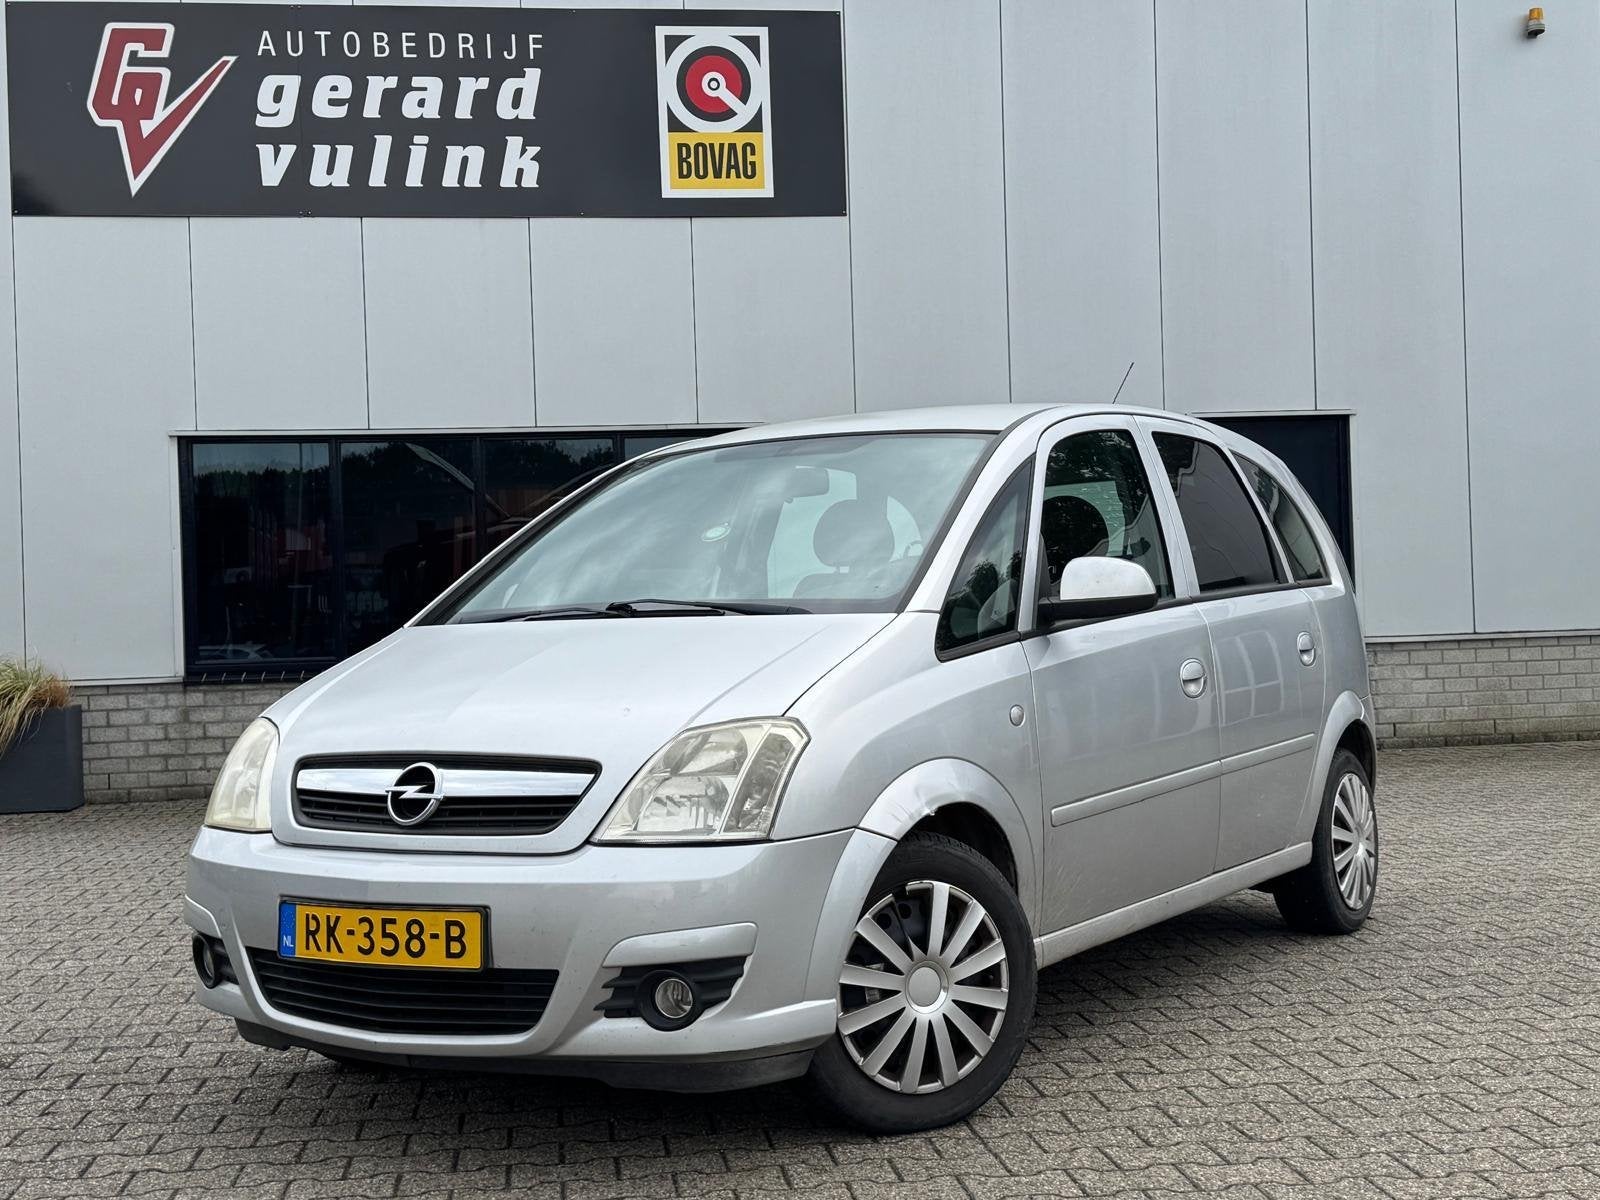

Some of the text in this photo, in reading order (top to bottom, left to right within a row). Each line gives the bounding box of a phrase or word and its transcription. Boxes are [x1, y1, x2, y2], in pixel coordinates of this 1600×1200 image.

[257, 30, 543, 59] AUTOBEDRIJF
[255, 68, 541, 128] gerard
[255, 134, 541, 188] vulink
[676, 141, 757, 180] BOVAG
[282, 912, 467, 960] NL RK-358-B
